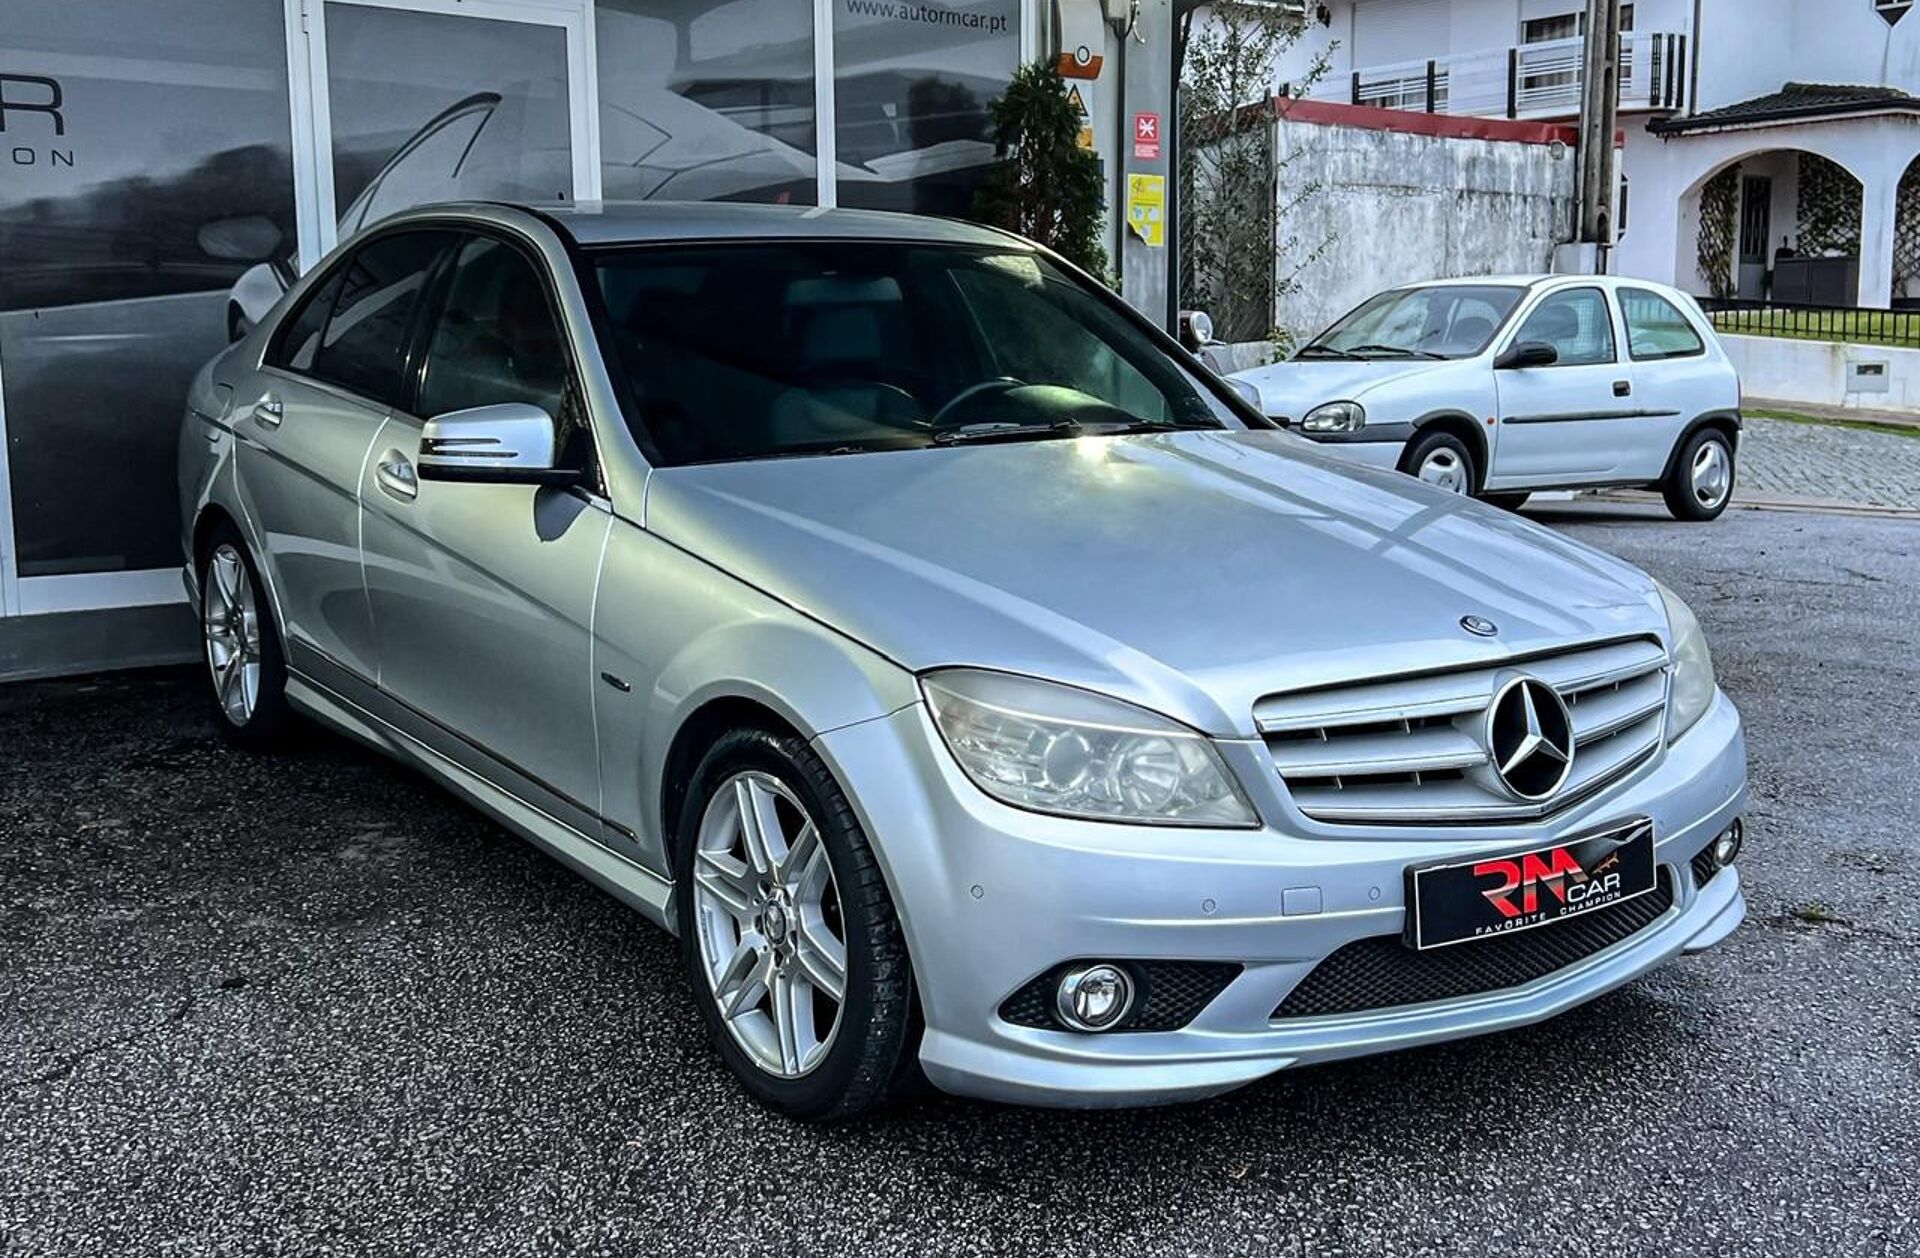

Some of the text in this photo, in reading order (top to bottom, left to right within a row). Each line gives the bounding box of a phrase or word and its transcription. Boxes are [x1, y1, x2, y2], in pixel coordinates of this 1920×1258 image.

[847, 0, 1007, 33] www.autormcar.pt
[1474, 848, 1621, 917] RM CAR
[1475, 891, 1621, 935] FAVORITE CHAMPION
